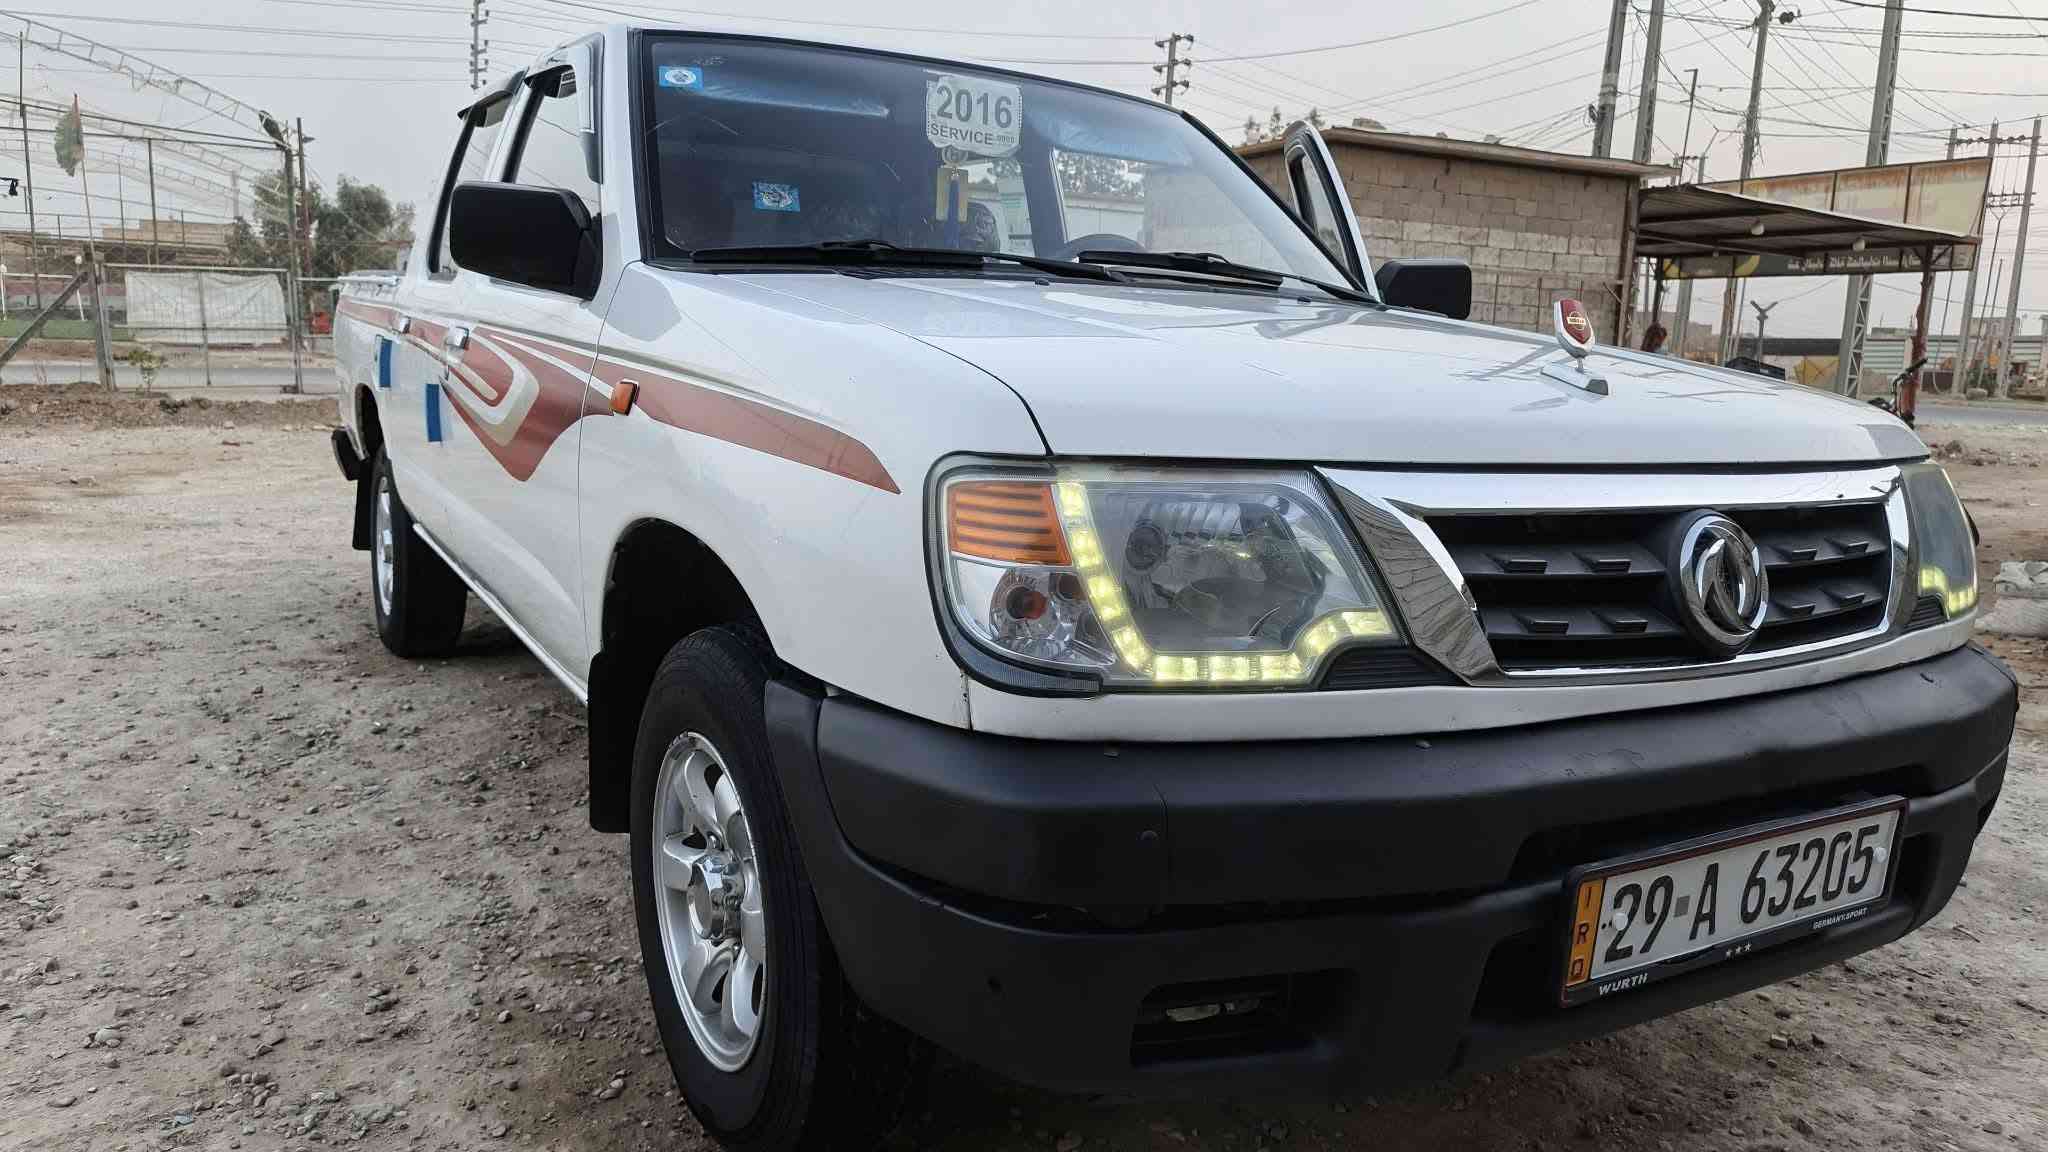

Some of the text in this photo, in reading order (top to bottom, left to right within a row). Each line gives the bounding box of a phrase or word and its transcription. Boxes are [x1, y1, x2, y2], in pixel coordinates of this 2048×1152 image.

[936, 85, 1012, 129] 2016
[930, 123, 993, 145] SERVICE
[1740, 824, 1880, 924] 63205
